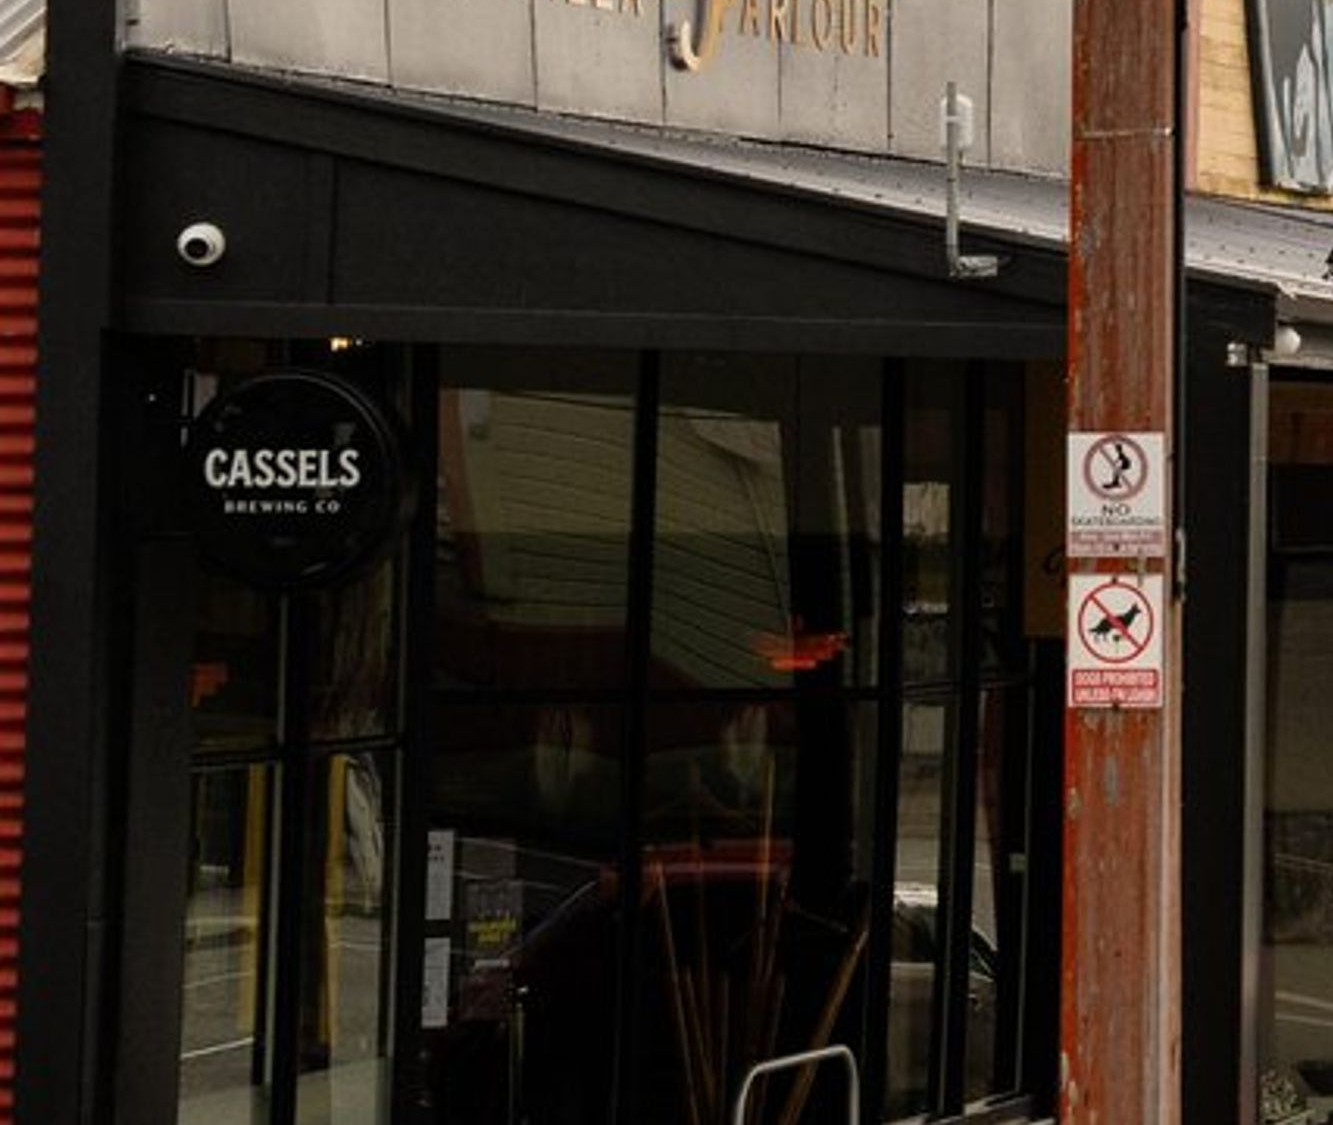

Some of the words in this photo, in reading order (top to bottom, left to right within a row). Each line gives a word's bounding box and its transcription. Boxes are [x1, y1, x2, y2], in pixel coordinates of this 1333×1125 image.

[204, 448, 361, 488] CASSELS
[224, 499, 308, 514] BREWING
[315, 499, 341, 514] CO
[1101, 503, 1131, 516] NO
